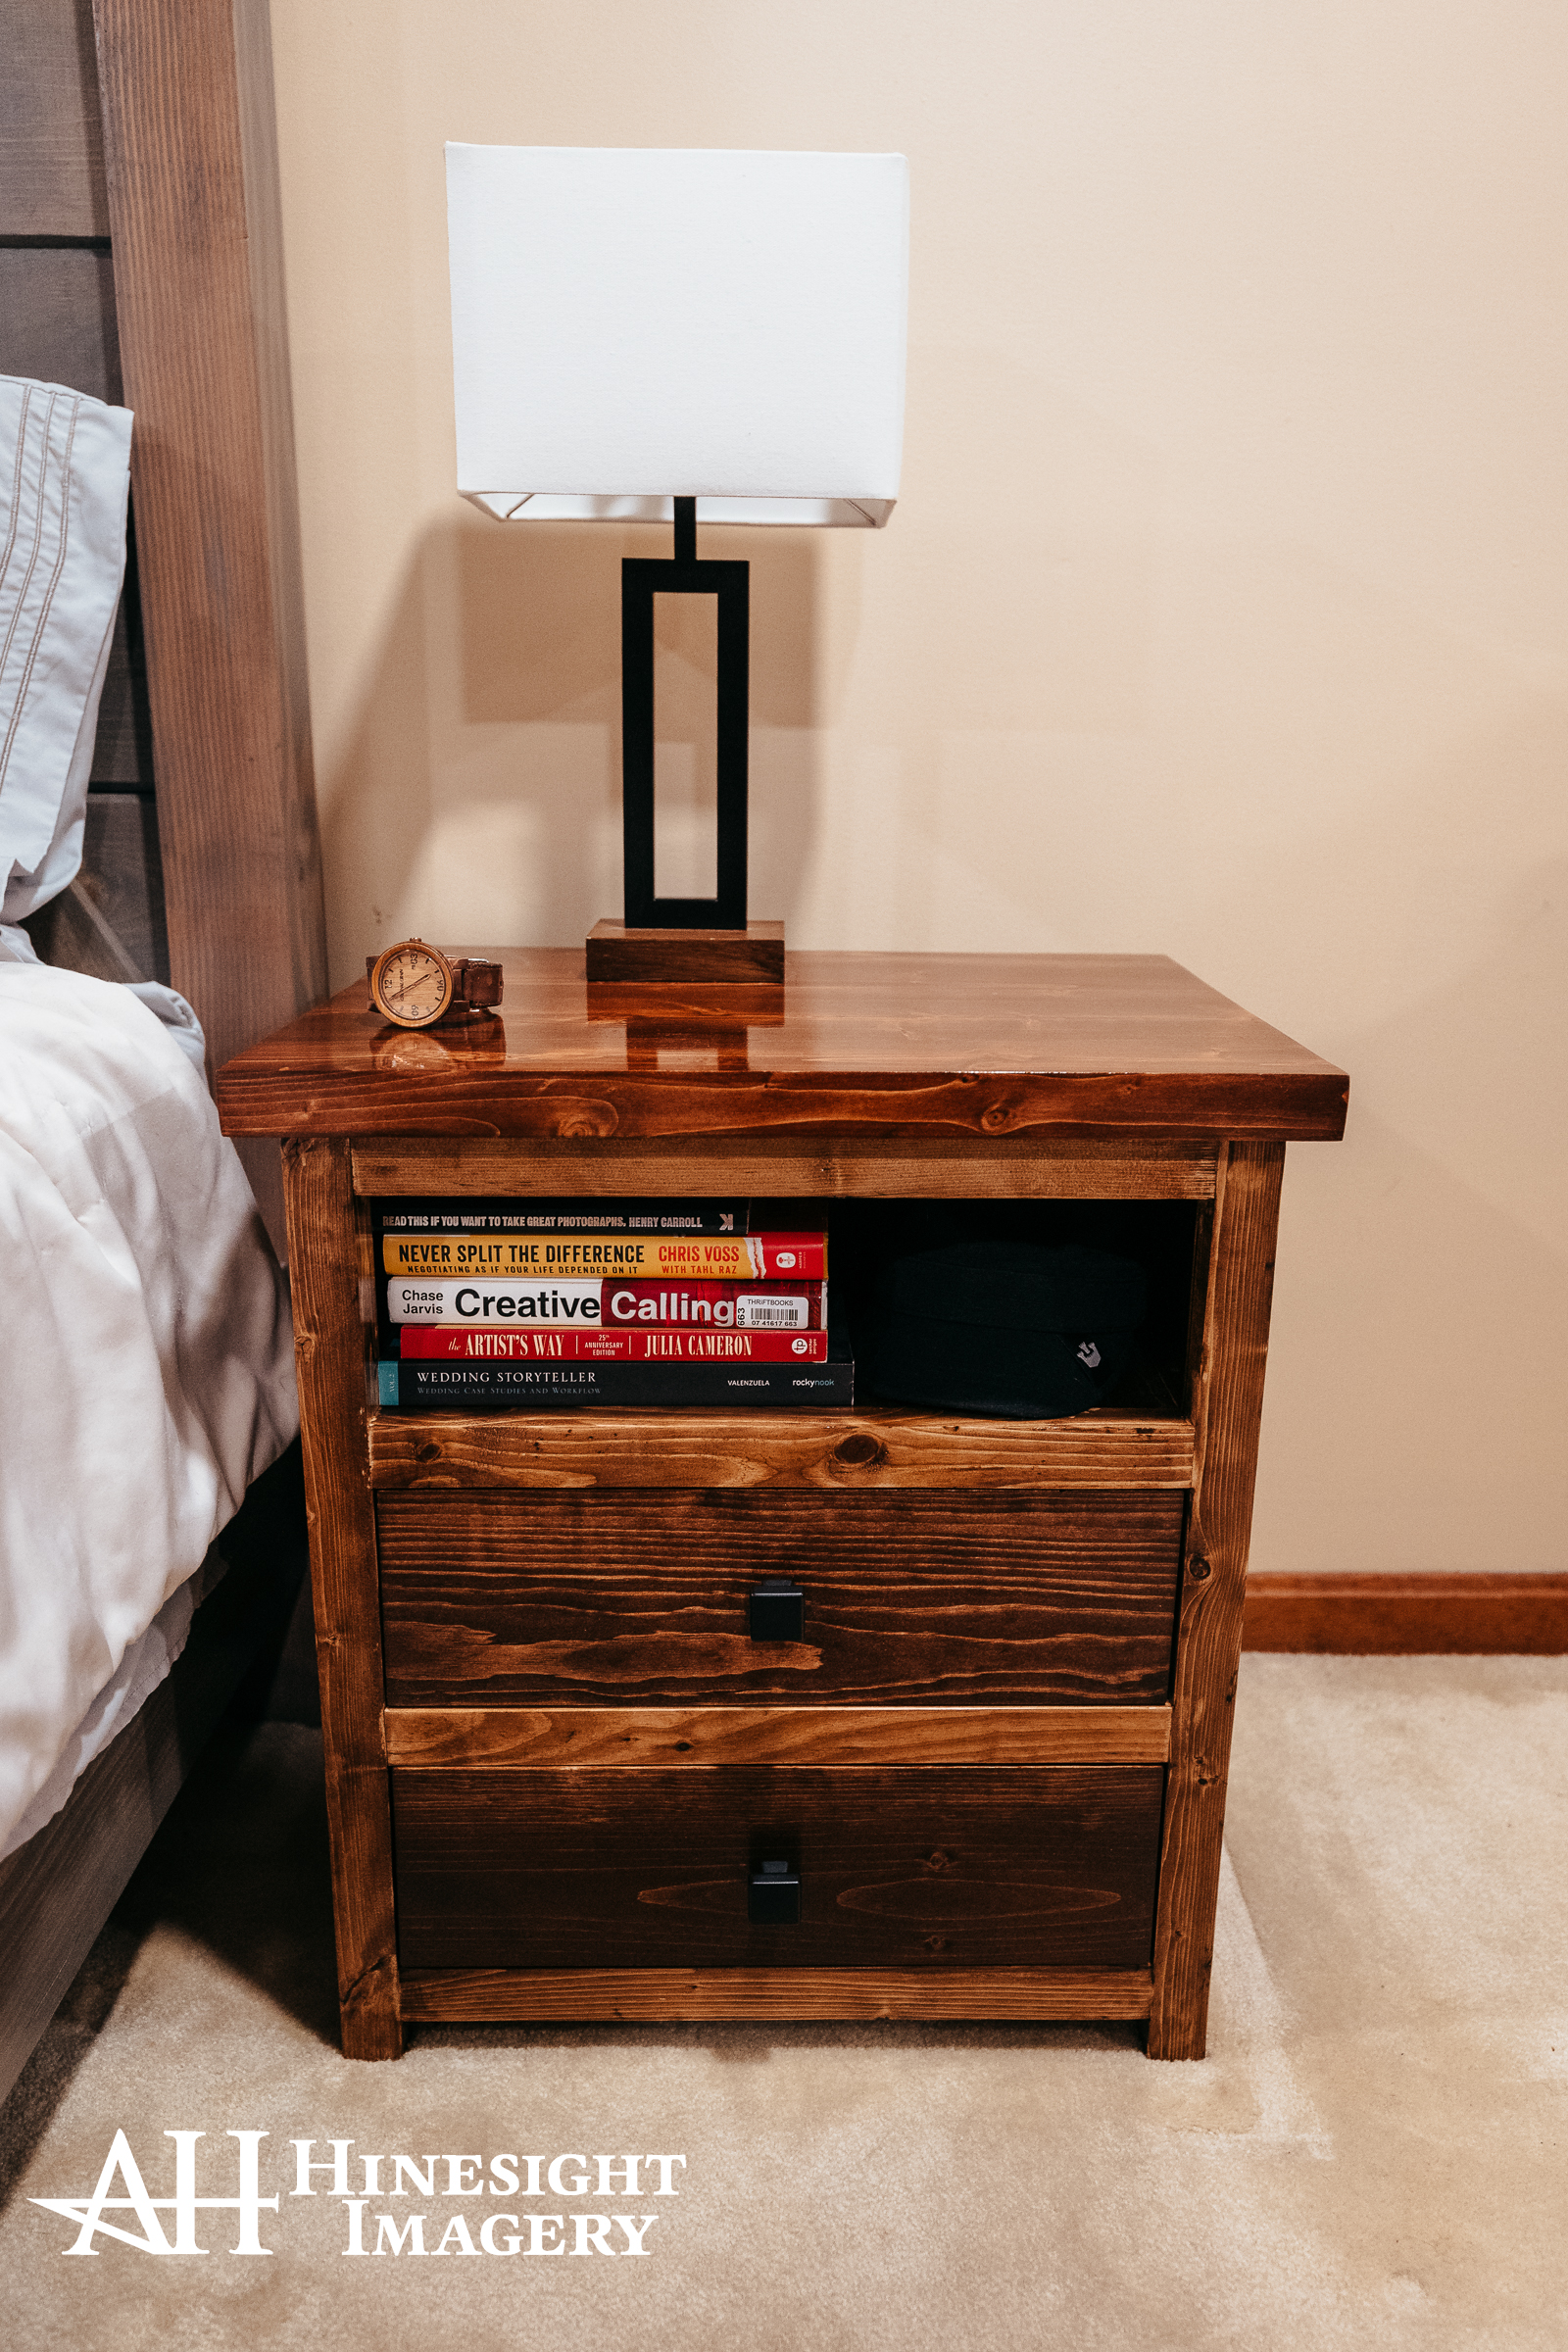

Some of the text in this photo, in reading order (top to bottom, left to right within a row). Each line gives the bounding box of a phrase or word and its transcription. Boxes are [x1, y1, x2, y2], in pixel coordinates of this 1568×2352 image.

[382, 1216, 407, 1227] READ
[407, 1216, 428, 1227] THIS
[430, 1216, 440, 1227] IF
[441, 1216, 459, 1227] YOU
[460, 1216, 486, 1227] WANT
[488, 1216, 501, 1227] TO
[502, 1216, 525, 1227] TAKE
[526, 1216, 556, 1227] GREAT
[628, 1216, 659, 1227] HENRY
[661, 1216, 703, 1227] CARROLL
[399, 1245, 740, 1263] NEVER SPLIT THE DIFFERENCE CHRIS VOSS
[408, 1265, 638, 1274] NEGOTIATING AS IF YOUR LIFE DEPENDED ON IT
[662, 1265, 737, 1274] WITH TAHL RAZ
[402, 1290, 444, 1301] Chase
[403, 1303, 444, 1314] Jarvis
[455, 1288, 734, 1327] Creative Calling
[737, 1307, 746, 1326] 663
[448, 1334, 564, 1356] the ARTIST'S WAY
[644, 1335, 753, 1357] JULIA CAMERON
[417, 1372, 596, 1383] WEDDING STORYTELLER
[792, 1378, 835, 1388] rockynook
